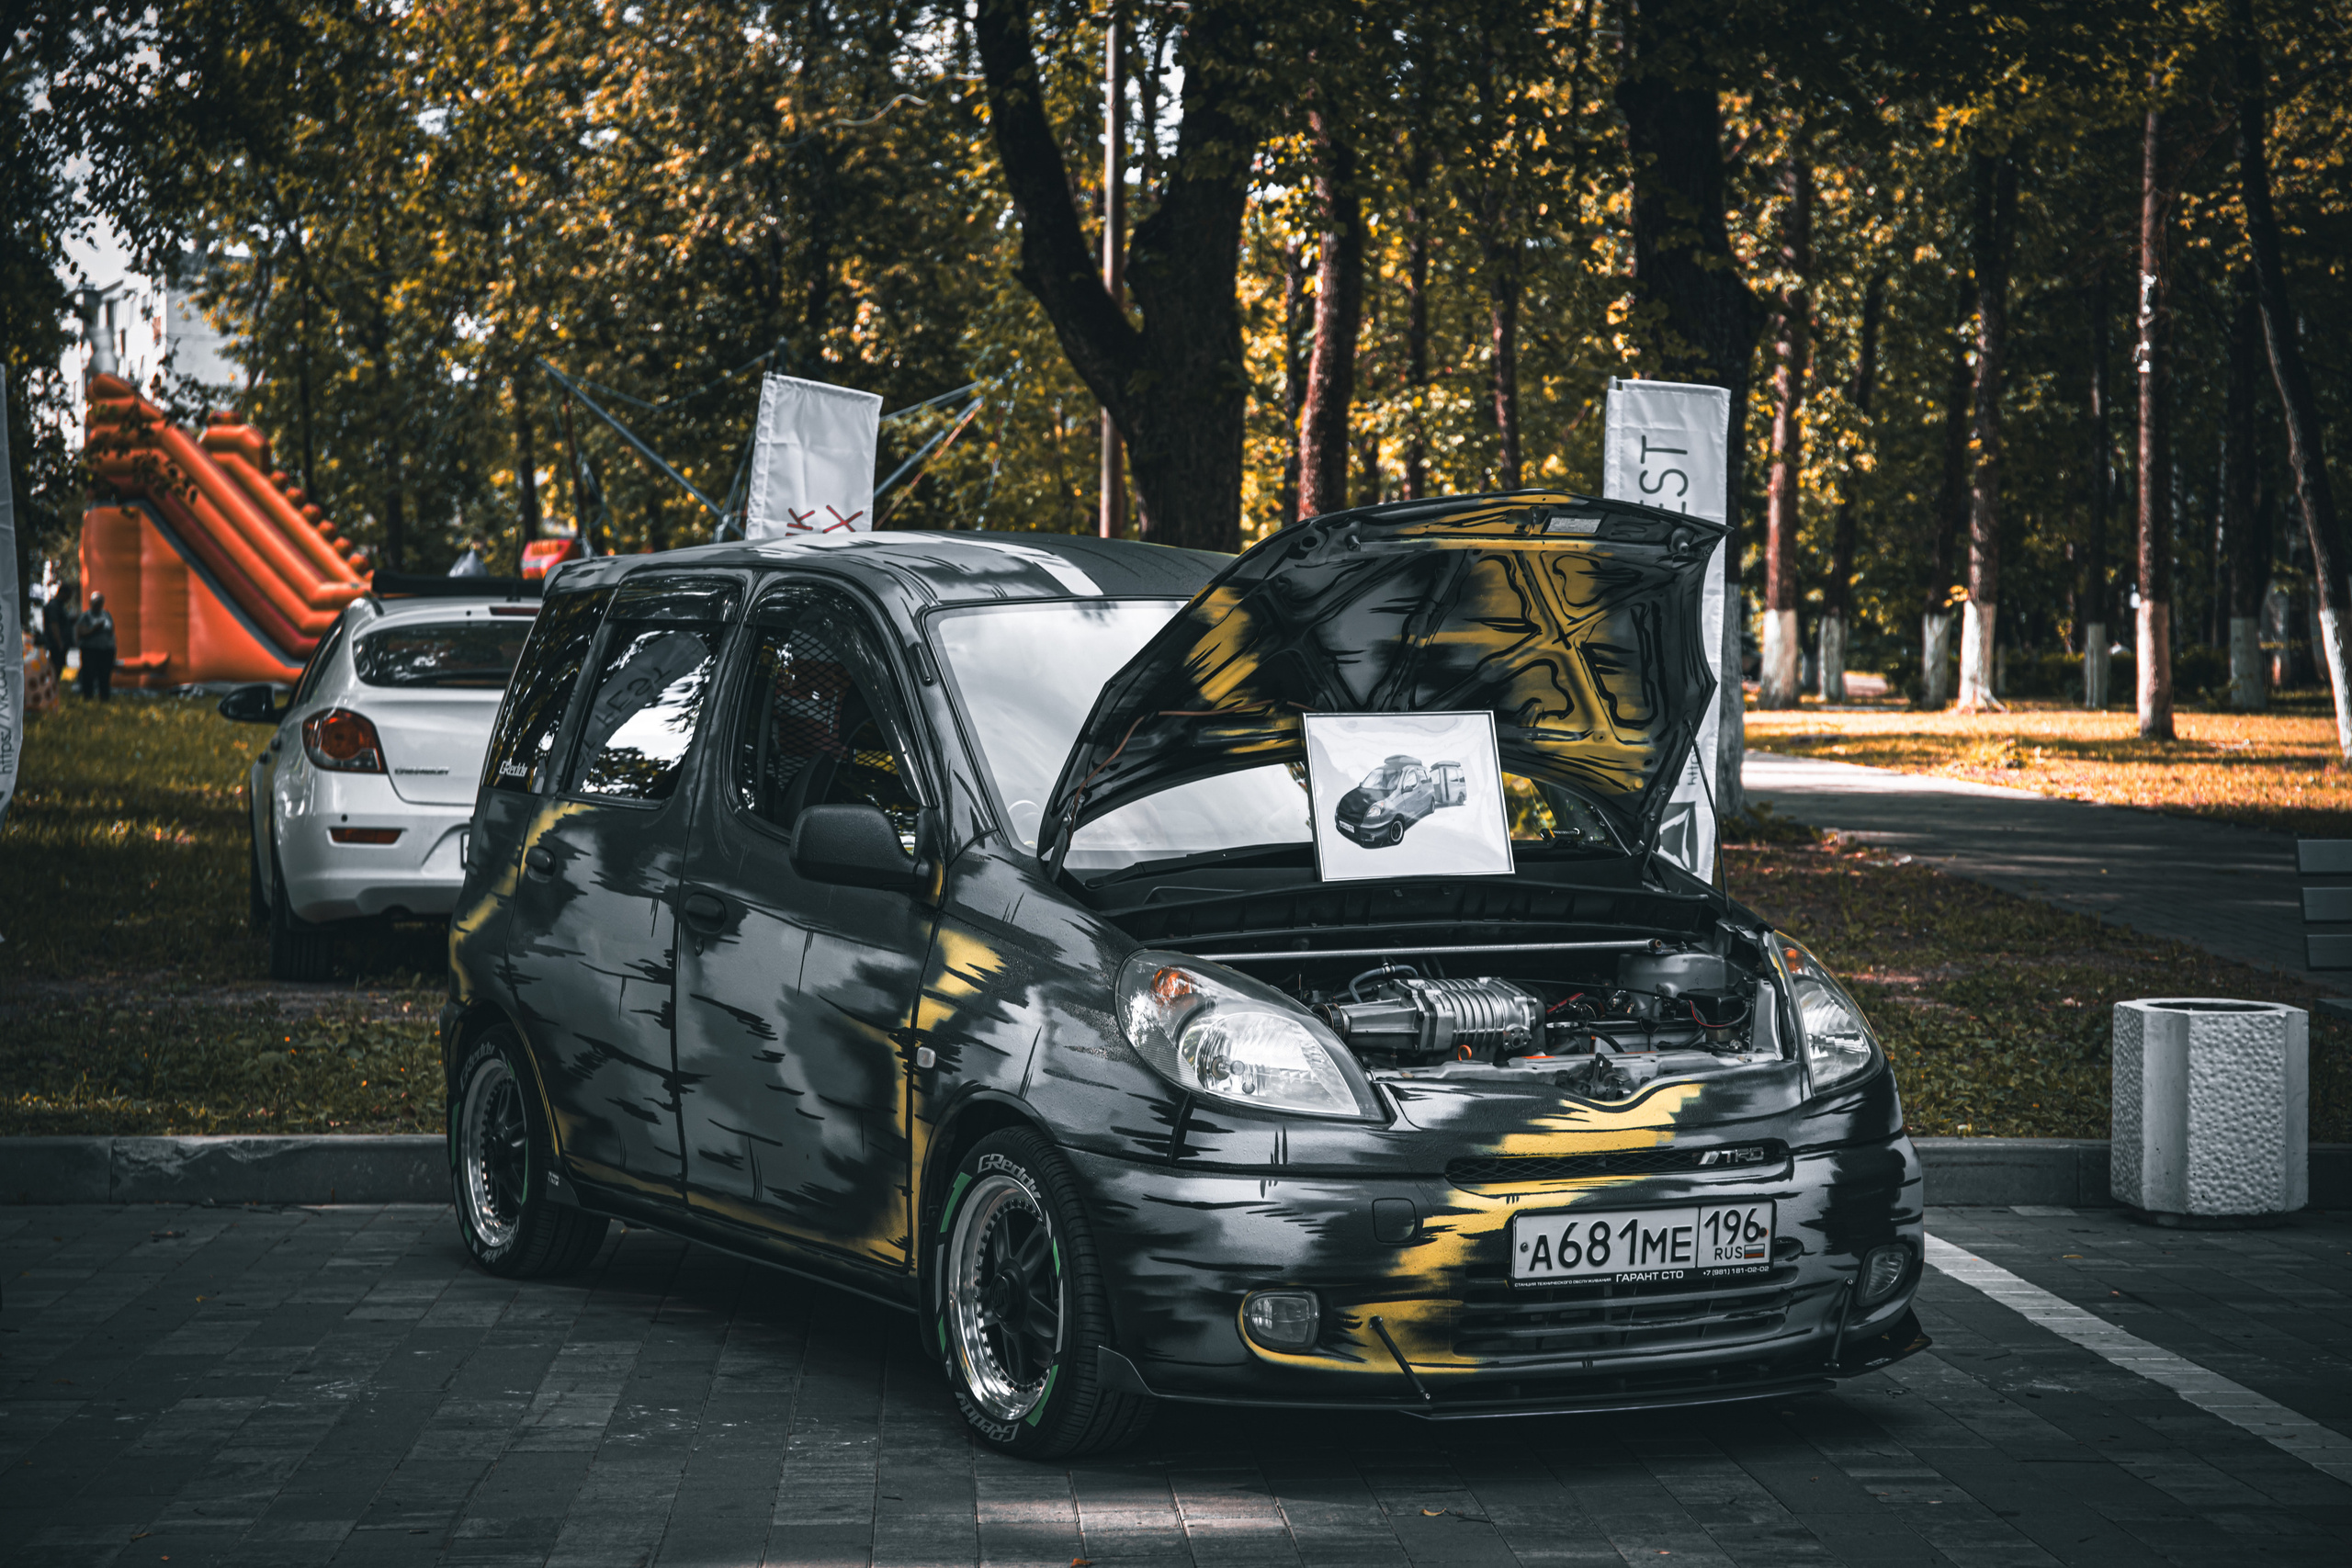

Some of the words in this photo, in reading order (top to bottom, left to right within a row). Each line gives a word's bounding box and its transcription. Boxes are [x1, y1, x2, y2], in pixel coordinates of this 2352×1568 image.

[978, 1153, 1042, 1200] GReddy
[1703, 1207, 1761, 1246] 196
[1713, 1246, 1743, 1261] RUS
[1616, 1271, 1659, 1283] ГАРАНТ
[1661, 1269, 1684, 1280] СТО
[1712, 1268, 1730, 1277] (981)
